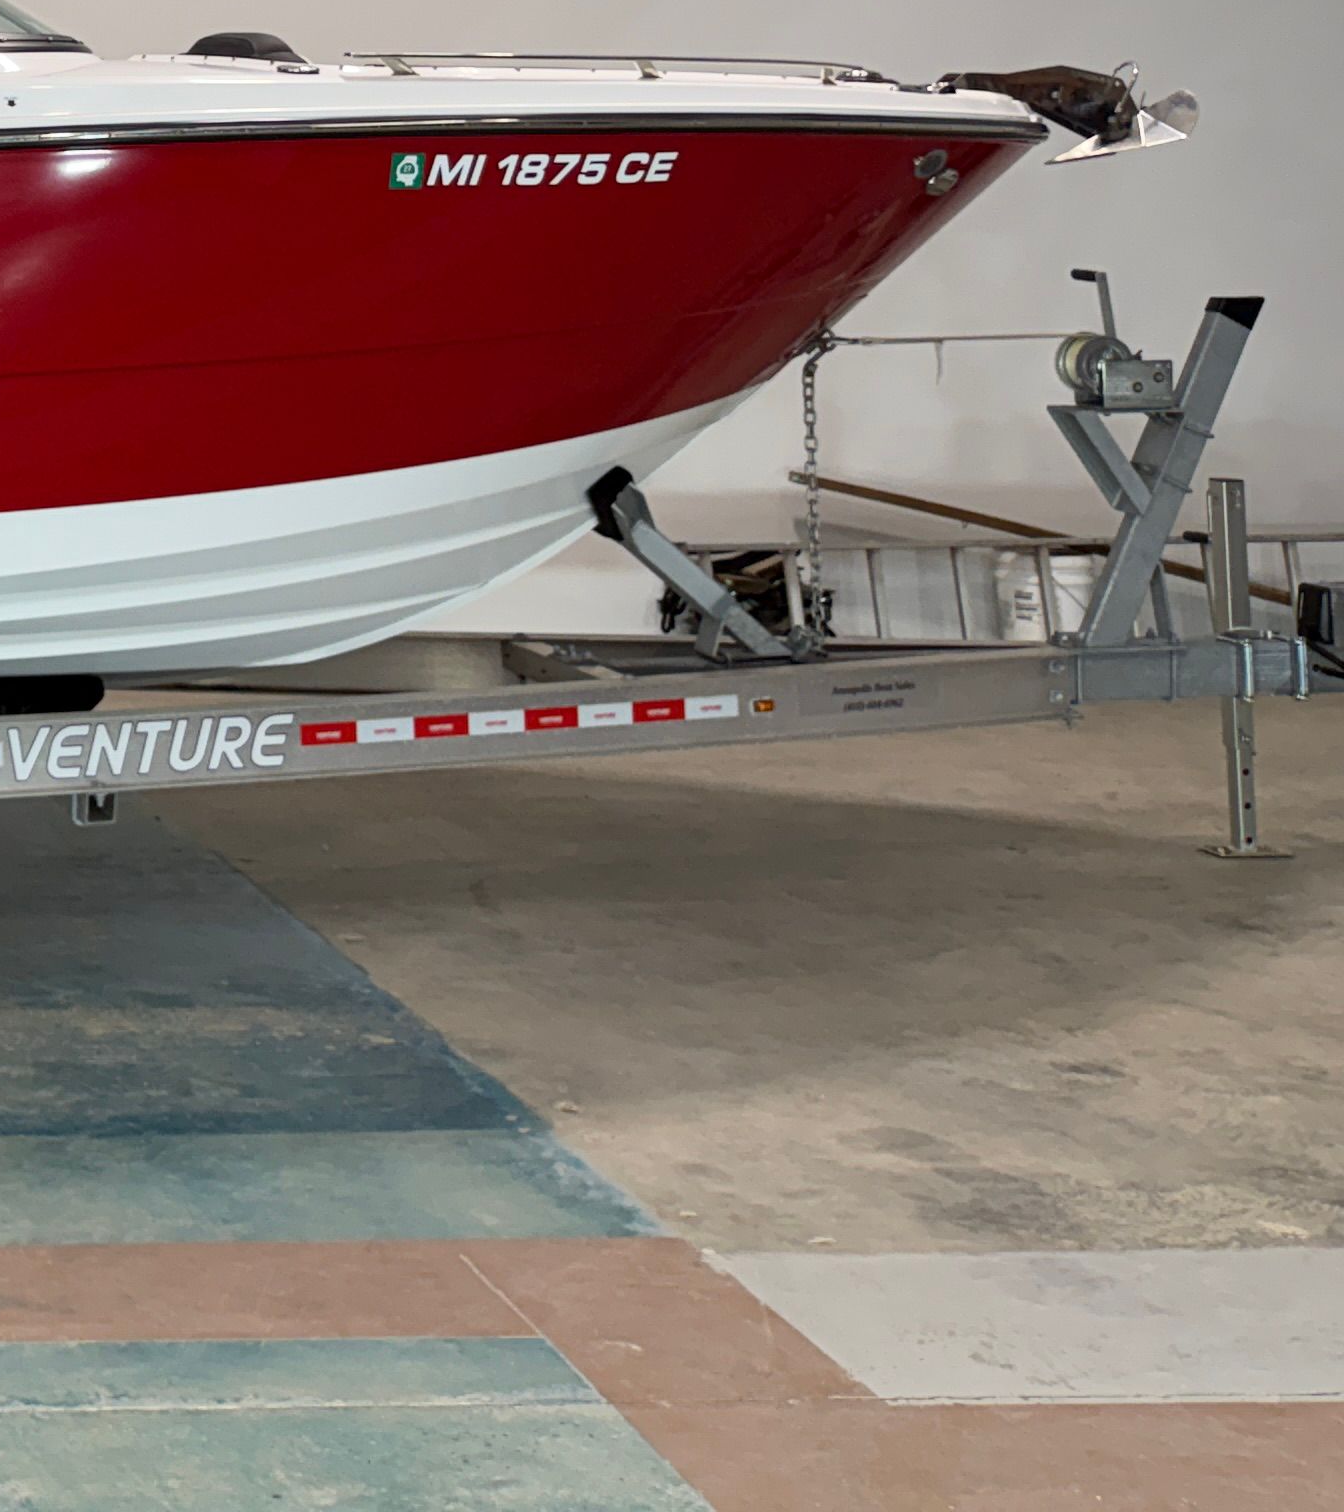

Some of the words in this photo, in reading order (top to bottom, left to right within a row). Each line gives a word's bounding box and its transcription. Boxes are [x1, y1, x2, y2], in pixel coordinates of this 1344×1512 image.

[427, 154, 487, 186] MI
[498, 154, 611, 186] 1875
[616, 152, 679, 184] CE
[7, 713, 294, 781] VENTURE
